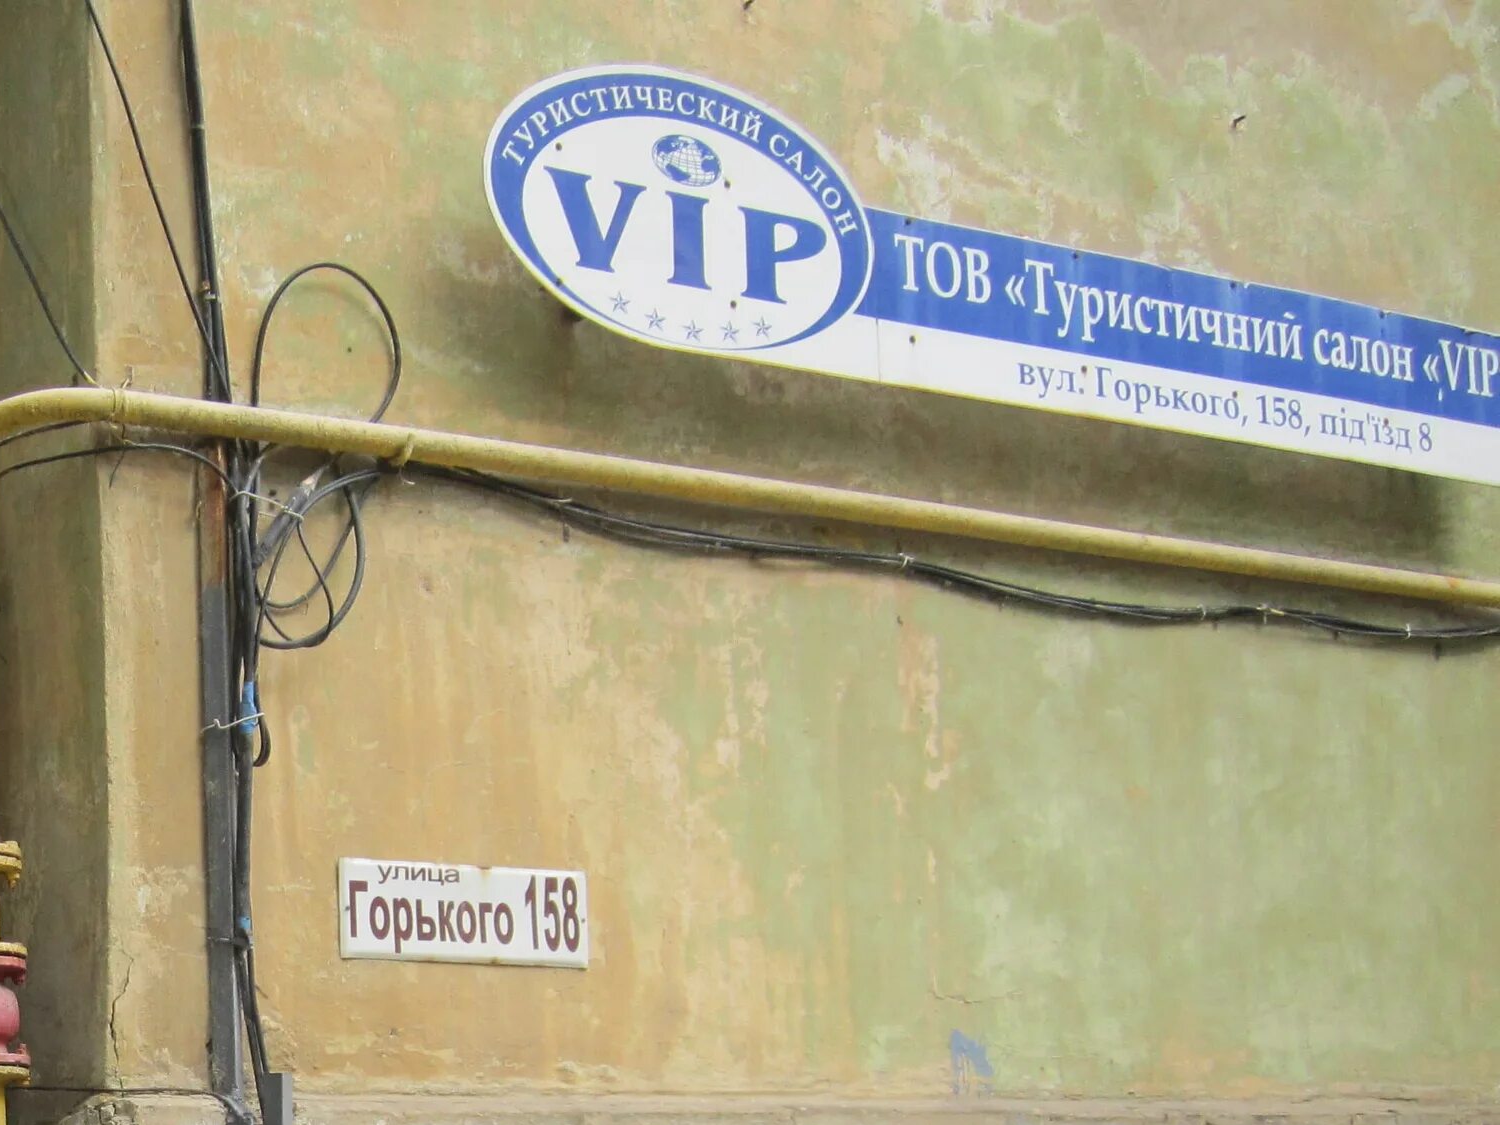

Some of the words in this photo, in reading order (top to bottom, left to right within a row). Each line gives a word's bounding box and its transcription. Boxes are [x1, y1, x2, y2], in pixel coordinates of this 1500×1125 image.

[501, 85, 765, 168] ТУРИСТИЧЕСКИЙ
[768, 133, 858, 237] САЛОН
[543, 165, 828, 305] VIP
[893, 233, 992, 305] ТОВ
[1004, 258, 1304, 362] «Туристичний
[1312, 327, 1415, 383] салон
[1017, 361, 1086, 399] вул.
[1094, 365, 1249, 428] Горького,
[1254, 394, 1312, 438] 158,
[1319, 406, 1414, 454] під'їзд
[1417, 422, 1434, 453] 8
[348, 880, 515, 954] Горького
[524, 874, 581, 953] 158
[377, 864, 461, 885] улица
